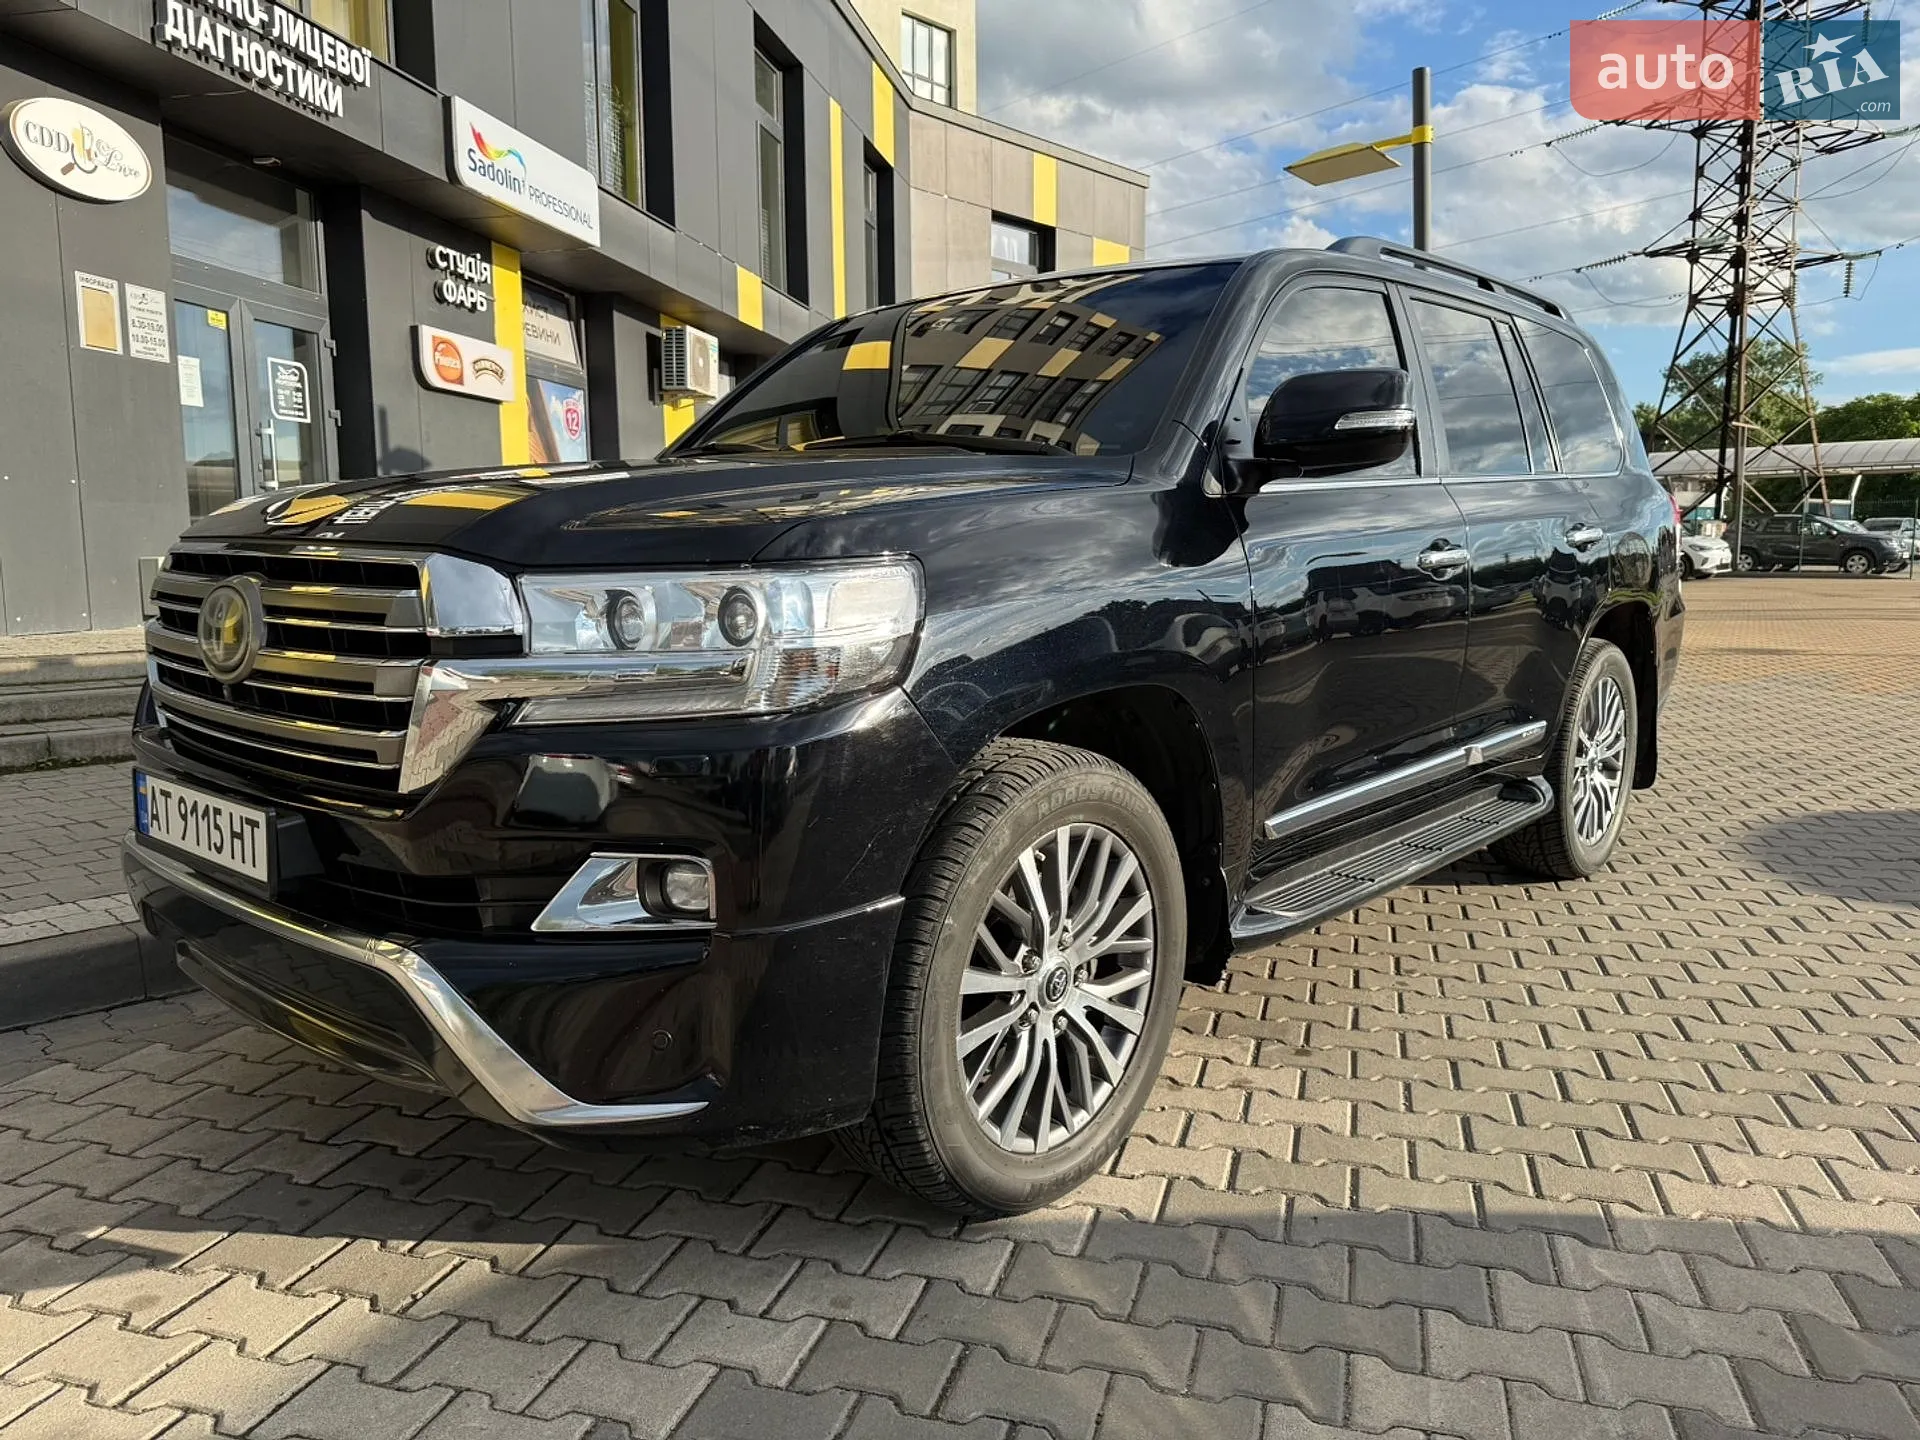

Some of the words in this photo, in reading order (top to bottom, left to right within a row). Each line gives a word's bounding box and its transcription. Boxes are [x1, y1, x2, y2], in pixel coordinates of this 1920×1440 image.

[164, 1, 344, 118] ДІАГНОСТИКИ
[467, 148, 523, 195] Sadolin
[528, 184, 594, 230] PROFESSIONAL
[442, 278, 488, 312] ФАРБ
[524, 321, 562, 347] ЕВИНИ
[565, 411, 580, 431] 12
[1036, 781, 1147, 822] ROADSTONE
[150, 785, 172, 835] AT
[177, 795, 225, 855] 9115
[229, 811, 261, 868] HT
